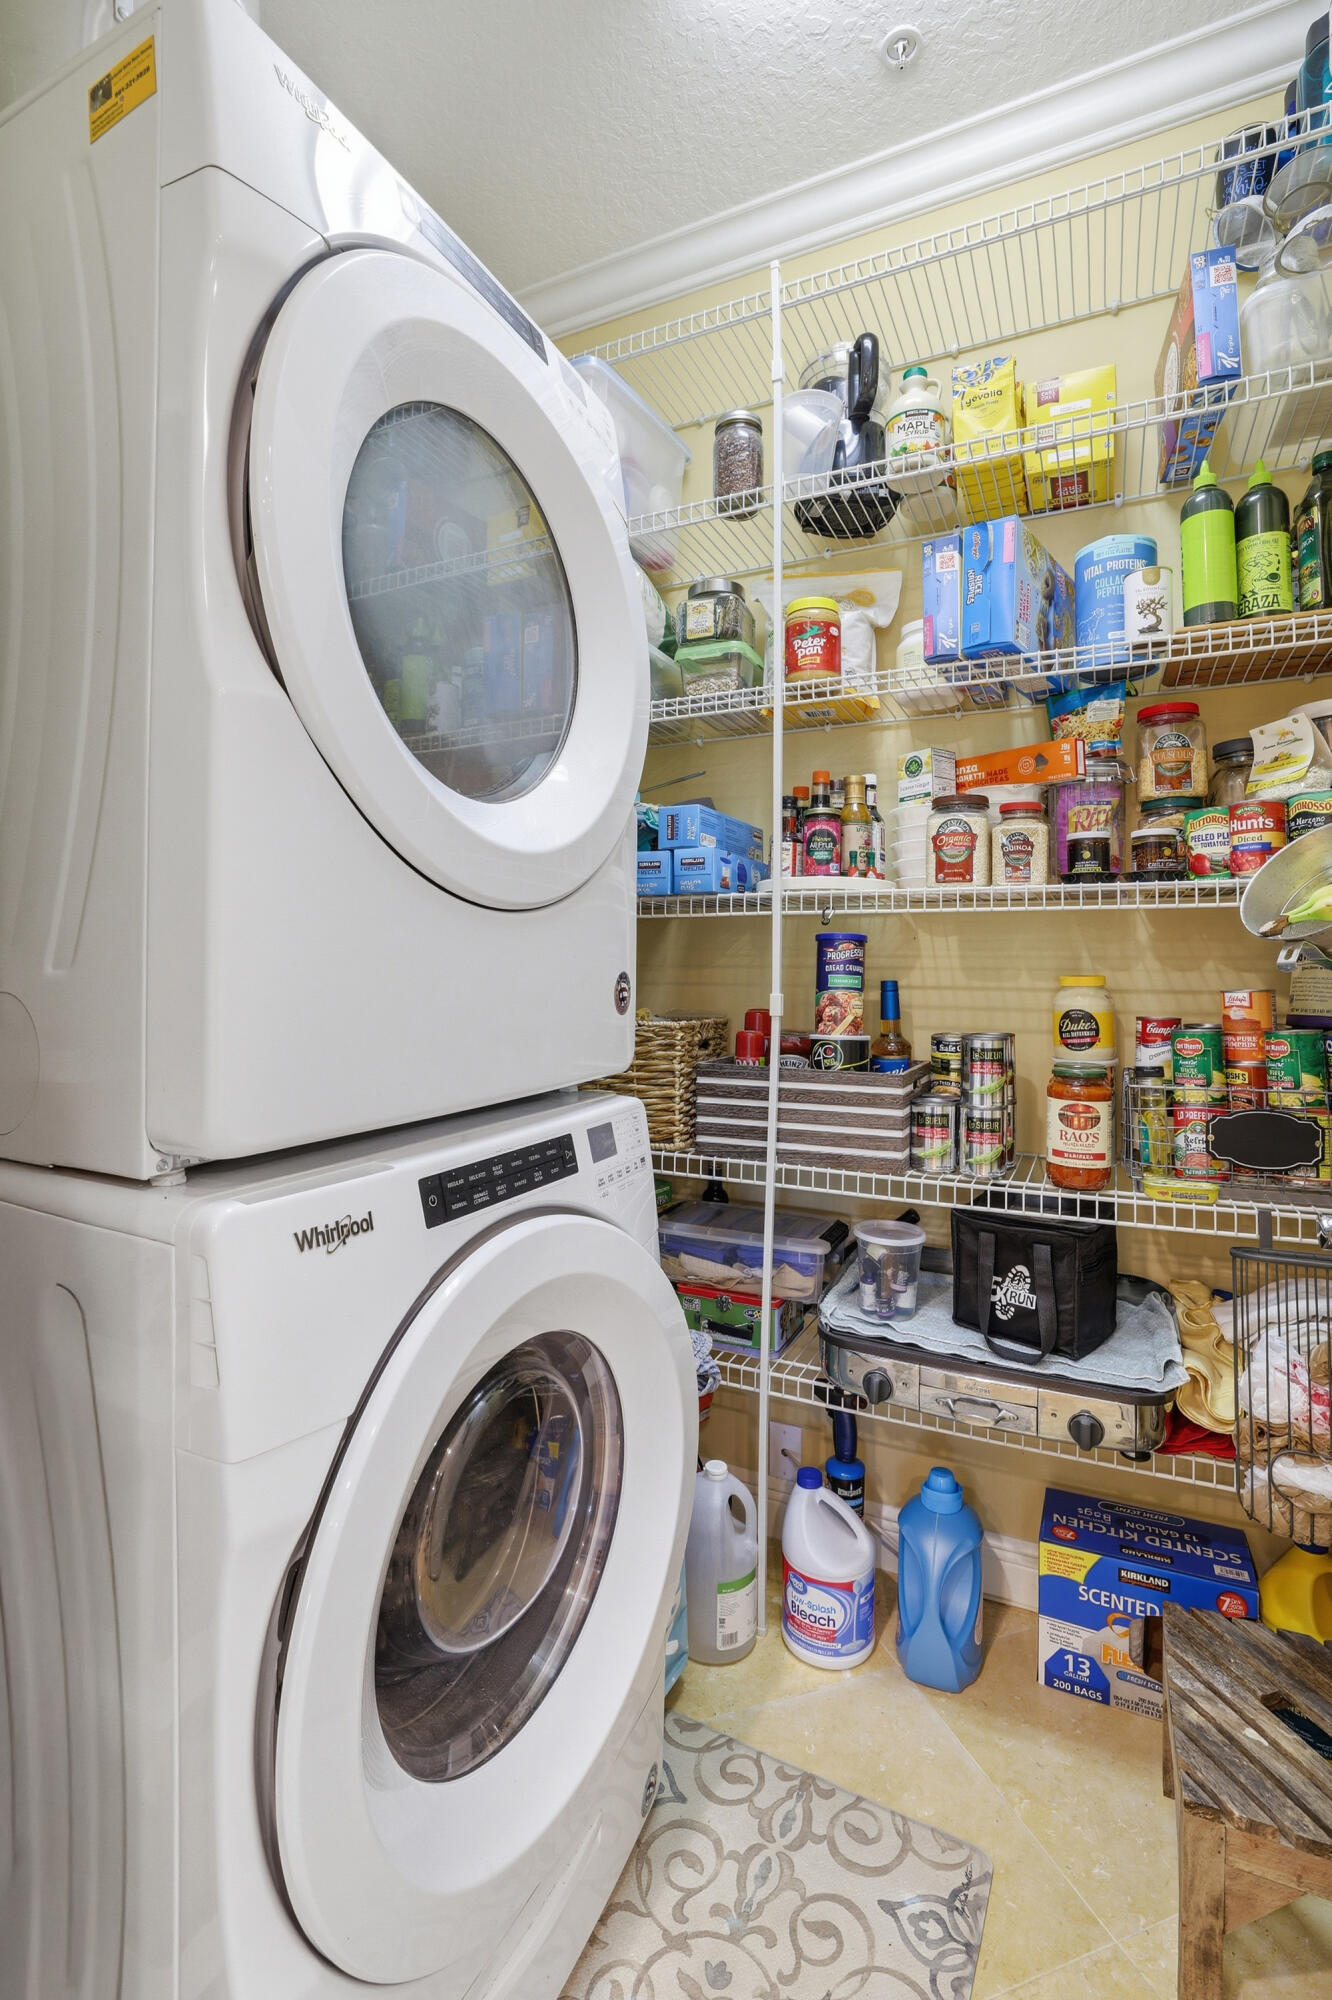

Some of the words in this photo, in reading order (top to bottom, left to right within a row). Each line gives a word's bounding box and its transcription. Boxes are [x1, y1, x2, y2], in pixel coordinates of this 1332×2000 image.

[897, 421, 936, 434] MAPLE
[1084, 563, 1105, 583] VITAL
[1106, 558, 1147, 572] PROTEINS
[975, 574, 984, 596] RICE
[793, 636, 827, 650] Peter
[987, 768, 1009, 777] MADE
[936, 834, 972, 849] Organic
[1190, 832, 1215, 843] PEELED
[1237, 834, 1263, 843] Diced
[1003, 844, 1032, 853] QUINOA
[1060, 1018, 1097, 1031] Duke's
[939, 1043, 957, 1052] Safe
[1059, 1129, 1101, 1144] RAO'S
[293, 1210, 374, 1253] Whirlpool
[1009, 1289, 1035, 1308] RUN
[1076, 1507, 1112, 1523] Bags
[1052, 1512, 1139, 1543] KITCHEN
[1124, 1520, 1180, 1538] GALLON
[1183, 1532, 1200, 1543] 13
[1121, 1547, 1172, 1565] KIRKLAND
[1144, 1534, 1243, 1565] SCENTED
[1120, 1569, 1169, 1588] KIRKLAND
[791, 1591, 837, 1615] Low-Splash
[1078, 1585, 1161, 1618] SCENTED
[1219, 1596, 1231, 1612] 7
[791, 1599, 837, 1628] Bleach
[1063, 1653, 1091, 1678] 13
[1063, 1669, 1091, 1683] GALLON
[1052, 1678, 1072, 1692] 200
[1073, 1684, 1103, 1701] BAGS
